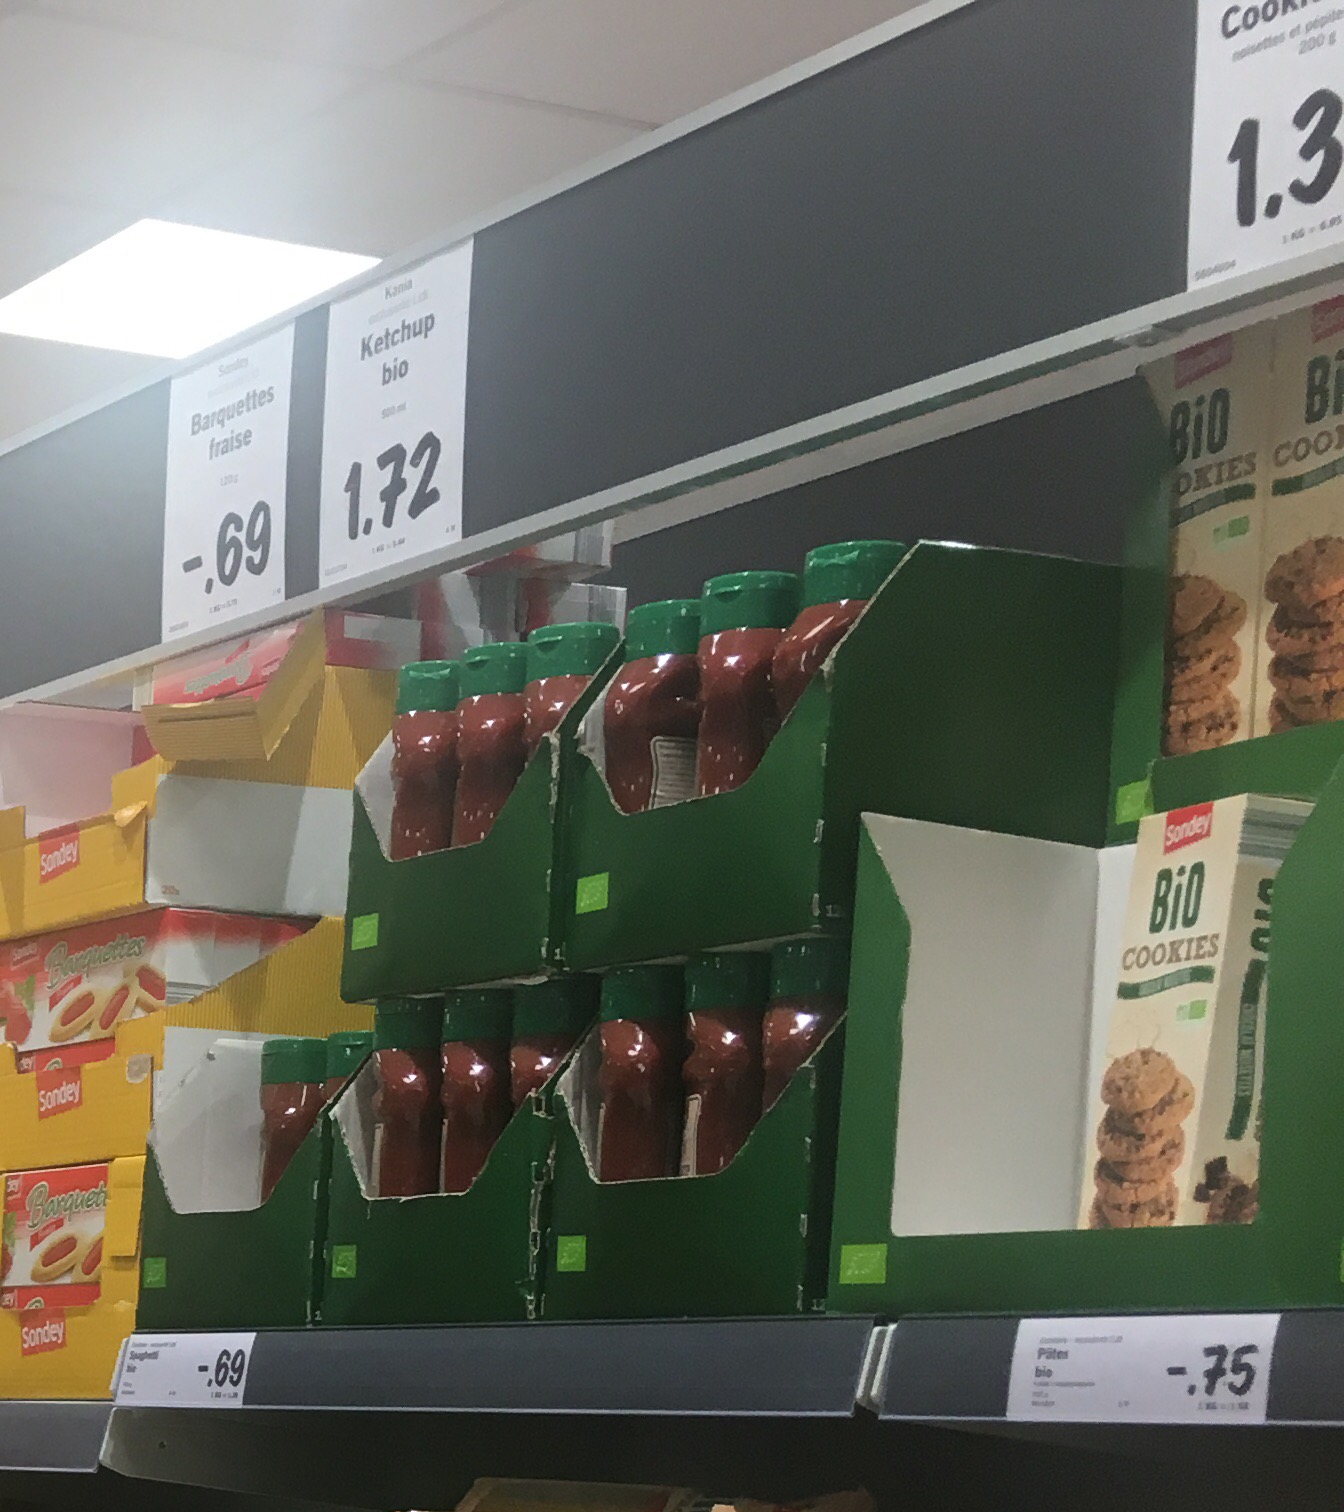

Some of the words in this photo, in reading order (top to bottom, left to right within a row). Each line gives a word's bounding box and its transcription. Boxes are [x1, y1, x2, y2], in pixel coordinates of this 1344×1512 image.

[360, 312, 436, 362] Ketchup
[381, 357, 410, 386] bio
[190, 384, 276, 438] Barquettes
[208, 426, 253, 461] fraise
[343, 430, 442, 541] 1.72
[182, 500, 272, 595] -.69
[1165, 811, 1212, 847] Sondey
[40, 838, 79, 877] Sondey
[1121, 933, 1220, 972] COOKIES
[38, 1080, 81, 1112] Sondey
[21, 1321, 65, 1350] Sondey
[197, 1348, 246, 1389] -.69
[1166, 1343, 1260, 1397] -.75
